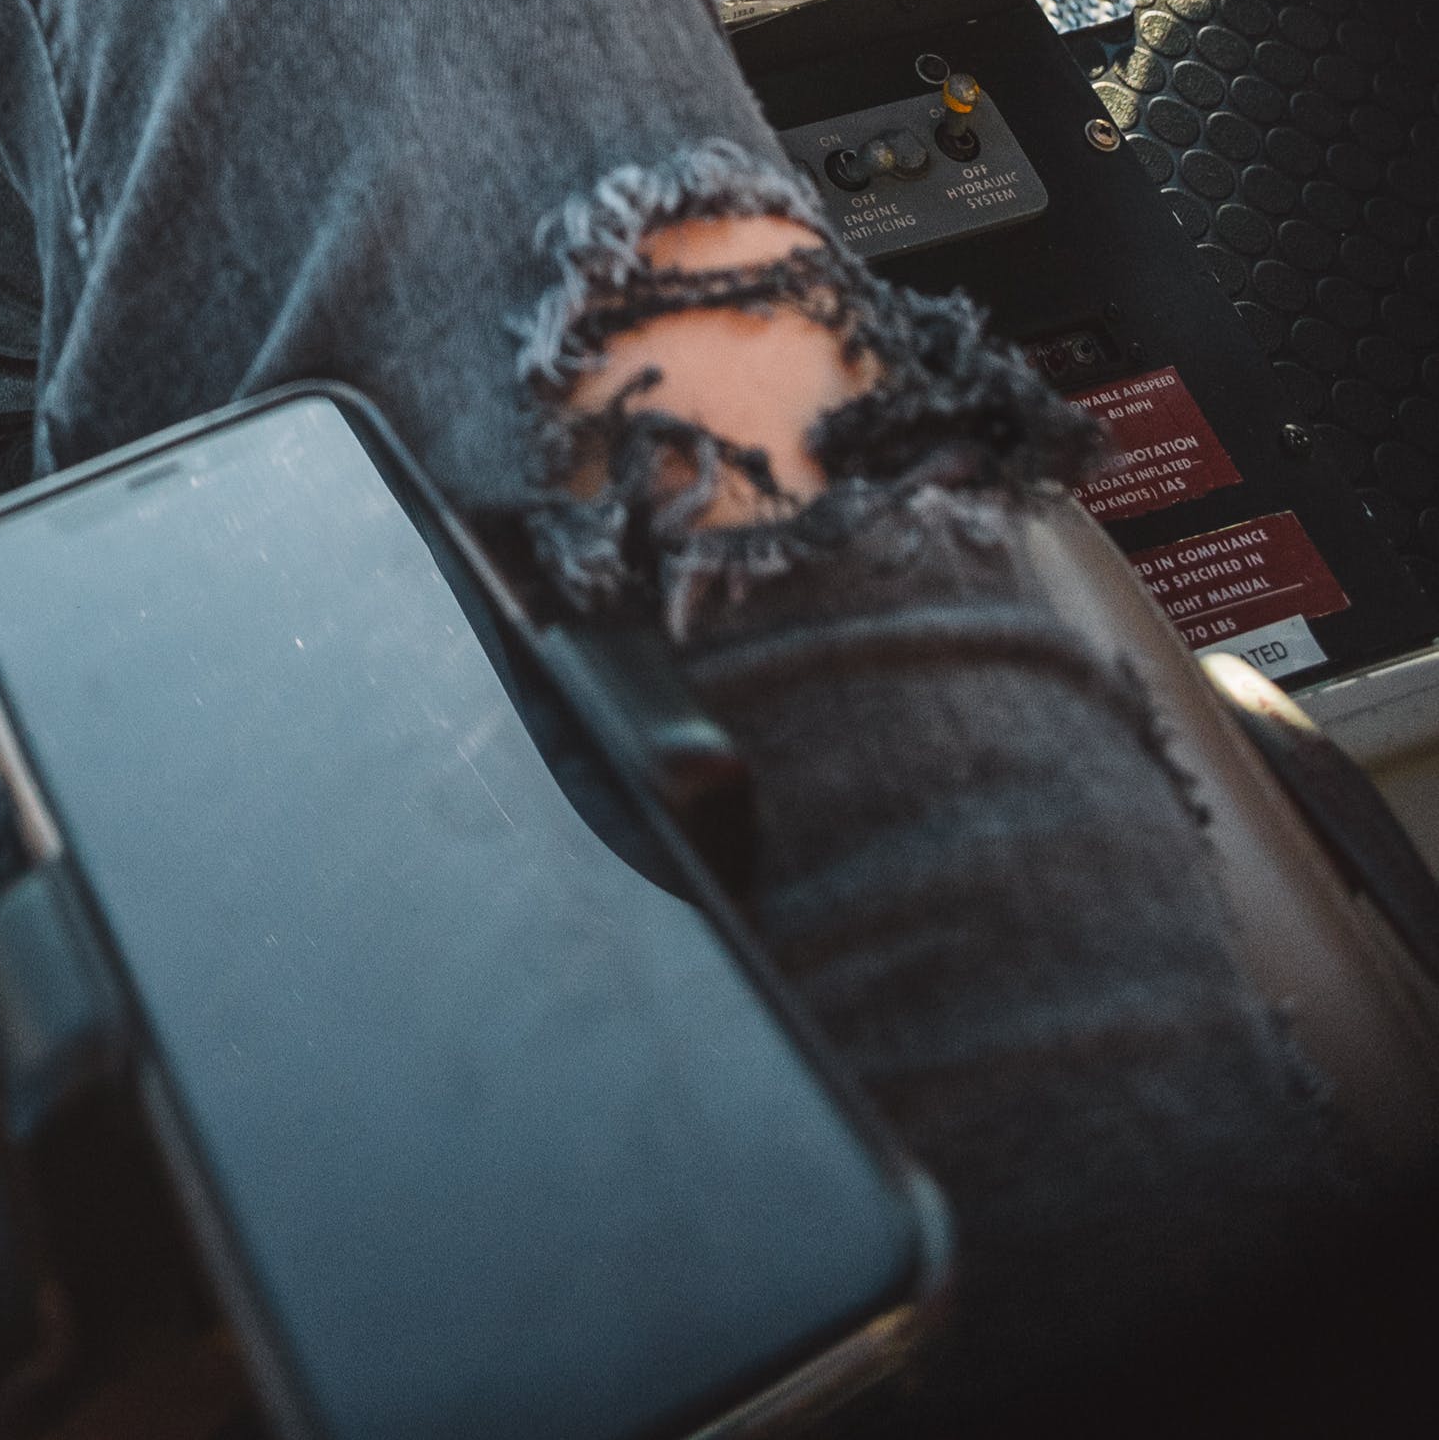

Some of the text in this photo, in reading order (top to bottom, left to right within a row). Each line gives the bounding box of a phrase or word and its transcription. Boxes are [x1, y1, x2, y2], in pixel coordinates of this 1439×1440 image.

[962, 163, 989, 179] OFF
[945, 172, 1020, 200] HYDRAULIC
[851, 193, 877, 209] OFF
[966, 188, 1017, 210] SYSTEM
[844, 203, 900, 227] ENGINE
[841, 214, 917, 243] ANTI-ICING
[1122, 374, 1176, 398] AIRSPEED
[1107, 398, 1154, 420] 80 MPH
[1087, 475, 1135, 495] FLOATS
[1089, 499, 1106, 514] 60
[1159, 477, 1187, 494] IAS
[1155, 528, 1270, 571] IN COMPLIANCE
[1173, 552, 1265, 589] SPECIFIED IN
[1207, 576, 1271, 604] MANUAL
[1211, 617, 1237, 636] LBS
